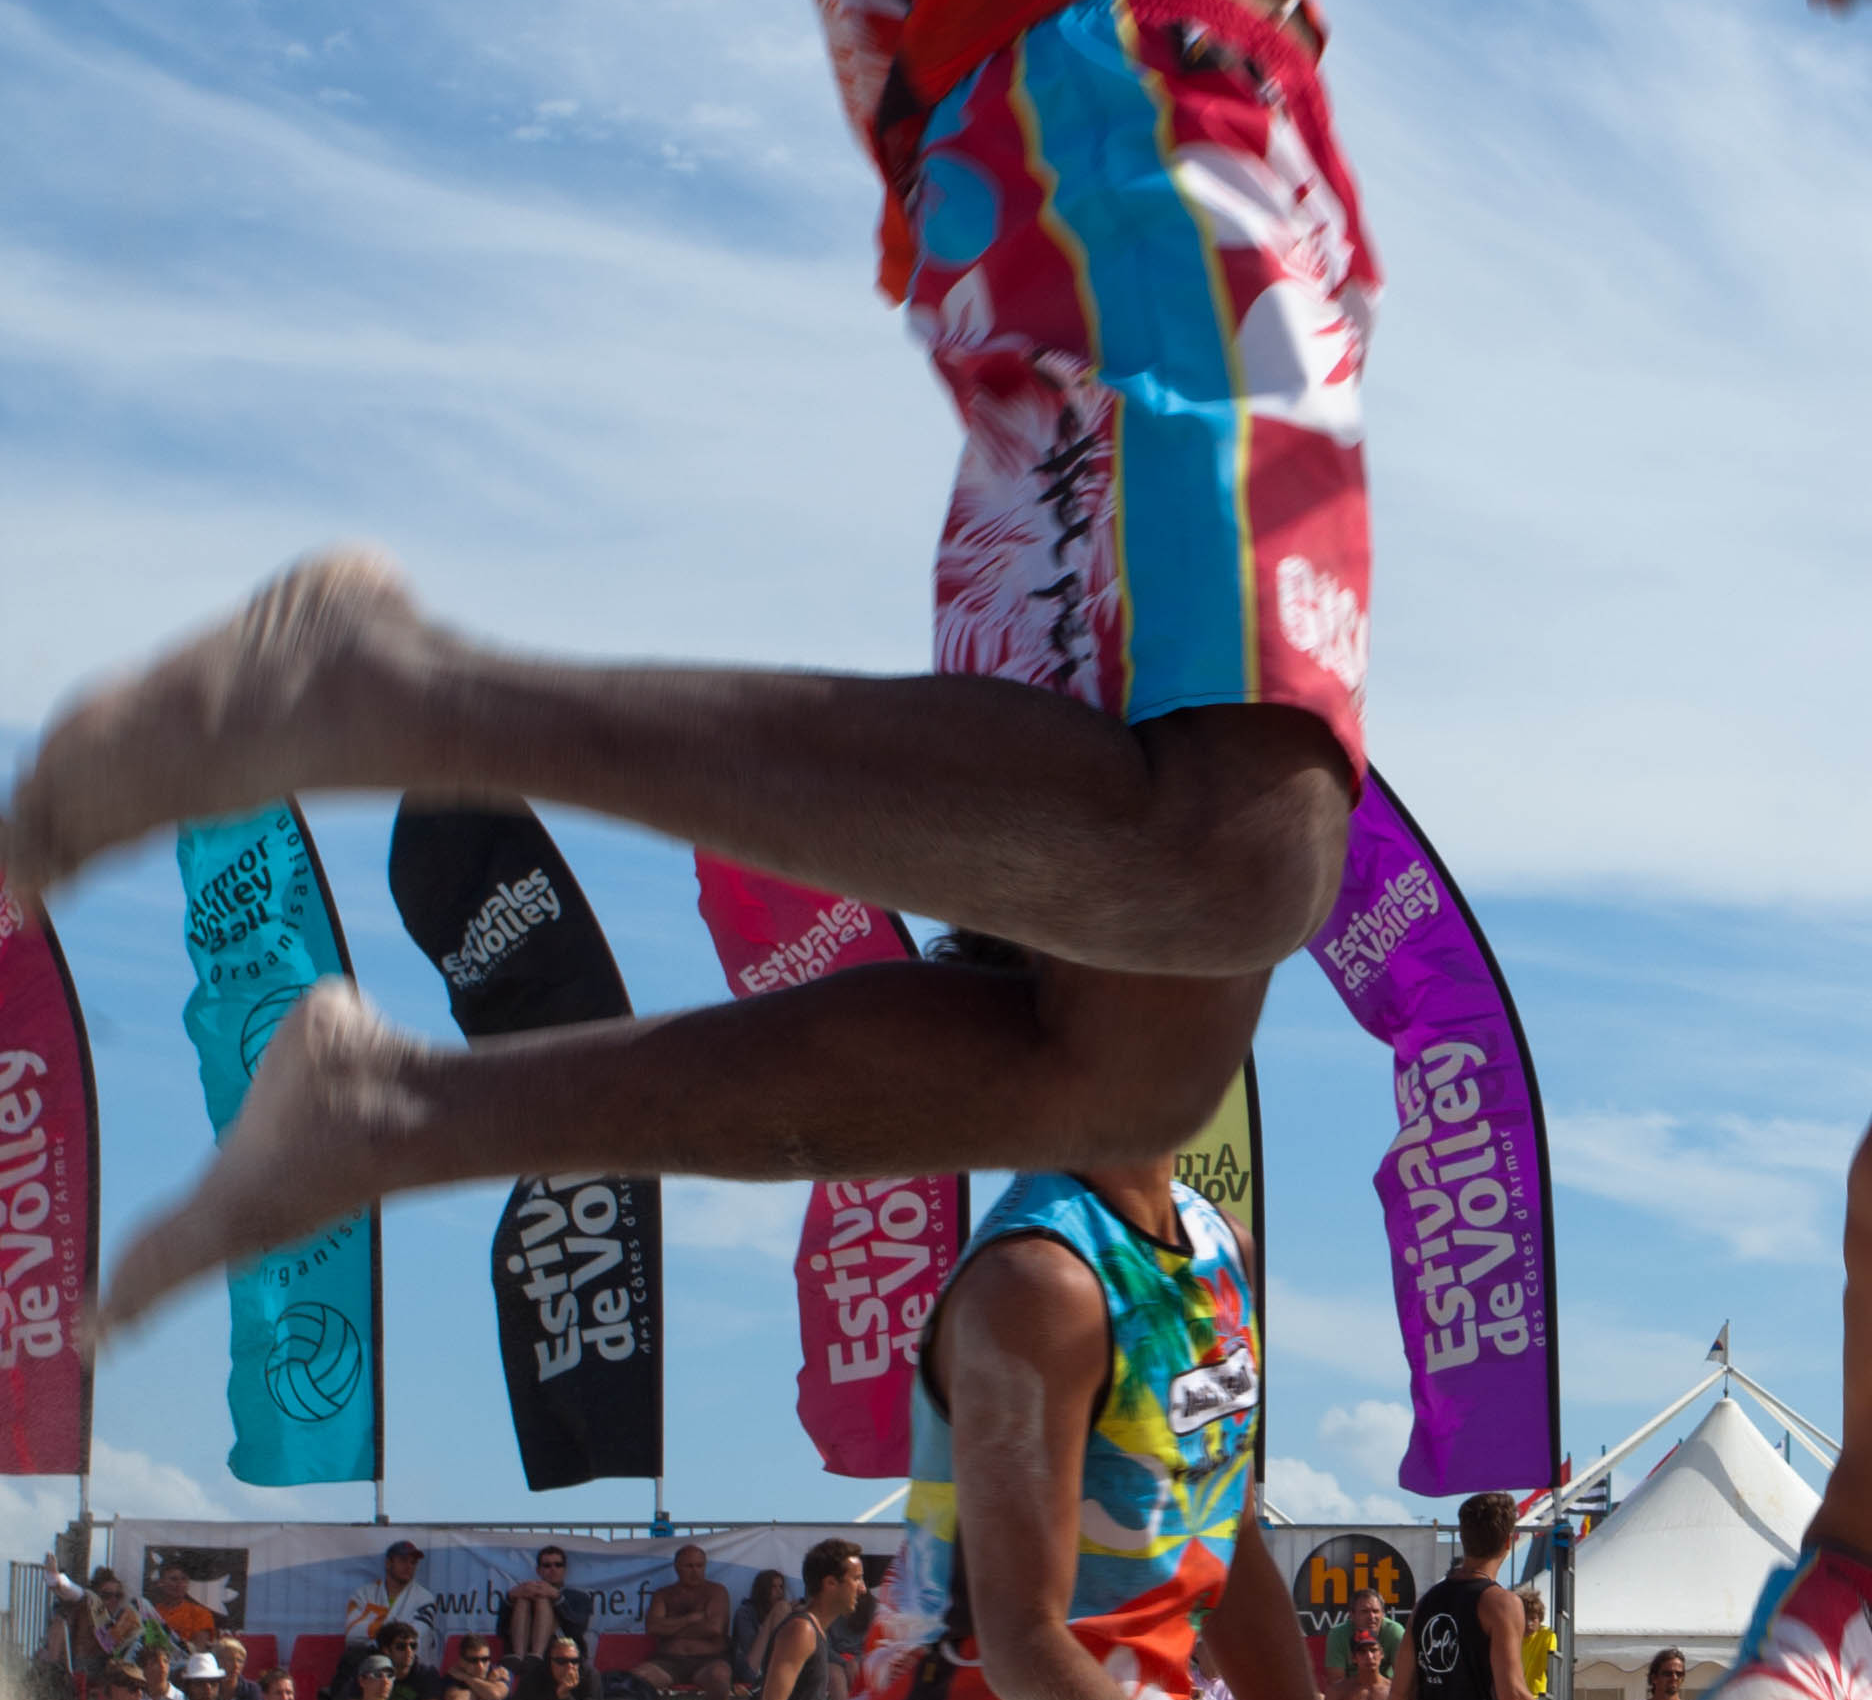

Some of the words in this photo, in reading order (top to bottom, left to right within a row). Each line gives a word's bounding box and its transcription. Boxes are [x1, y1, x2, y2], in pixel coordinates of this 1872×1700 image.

[210, 815, 309, 986] Organisation
[470, 887, 561, 965] Volley
[1324, 860, 1428, 970] Estivales
[1344, 961, 1371, 990] de
[1358, 881, 1439, 963] Volley
[738, 896, 861, 993] Estivales
[1420, 1041, 1488, 1287] Volley
[1500, 1130, 1528, 1221] d'Armor
[628, 1237, 648, 1303] Côtes
[1521, 1232, 1540, 1297] Côtes
[581, 1287, 636, 1361] de
[1479, 1282, 1530, 1356] de
[1533, 1309, 1547, 1348] des
[1311, 1552, 1400, 1604] hit
